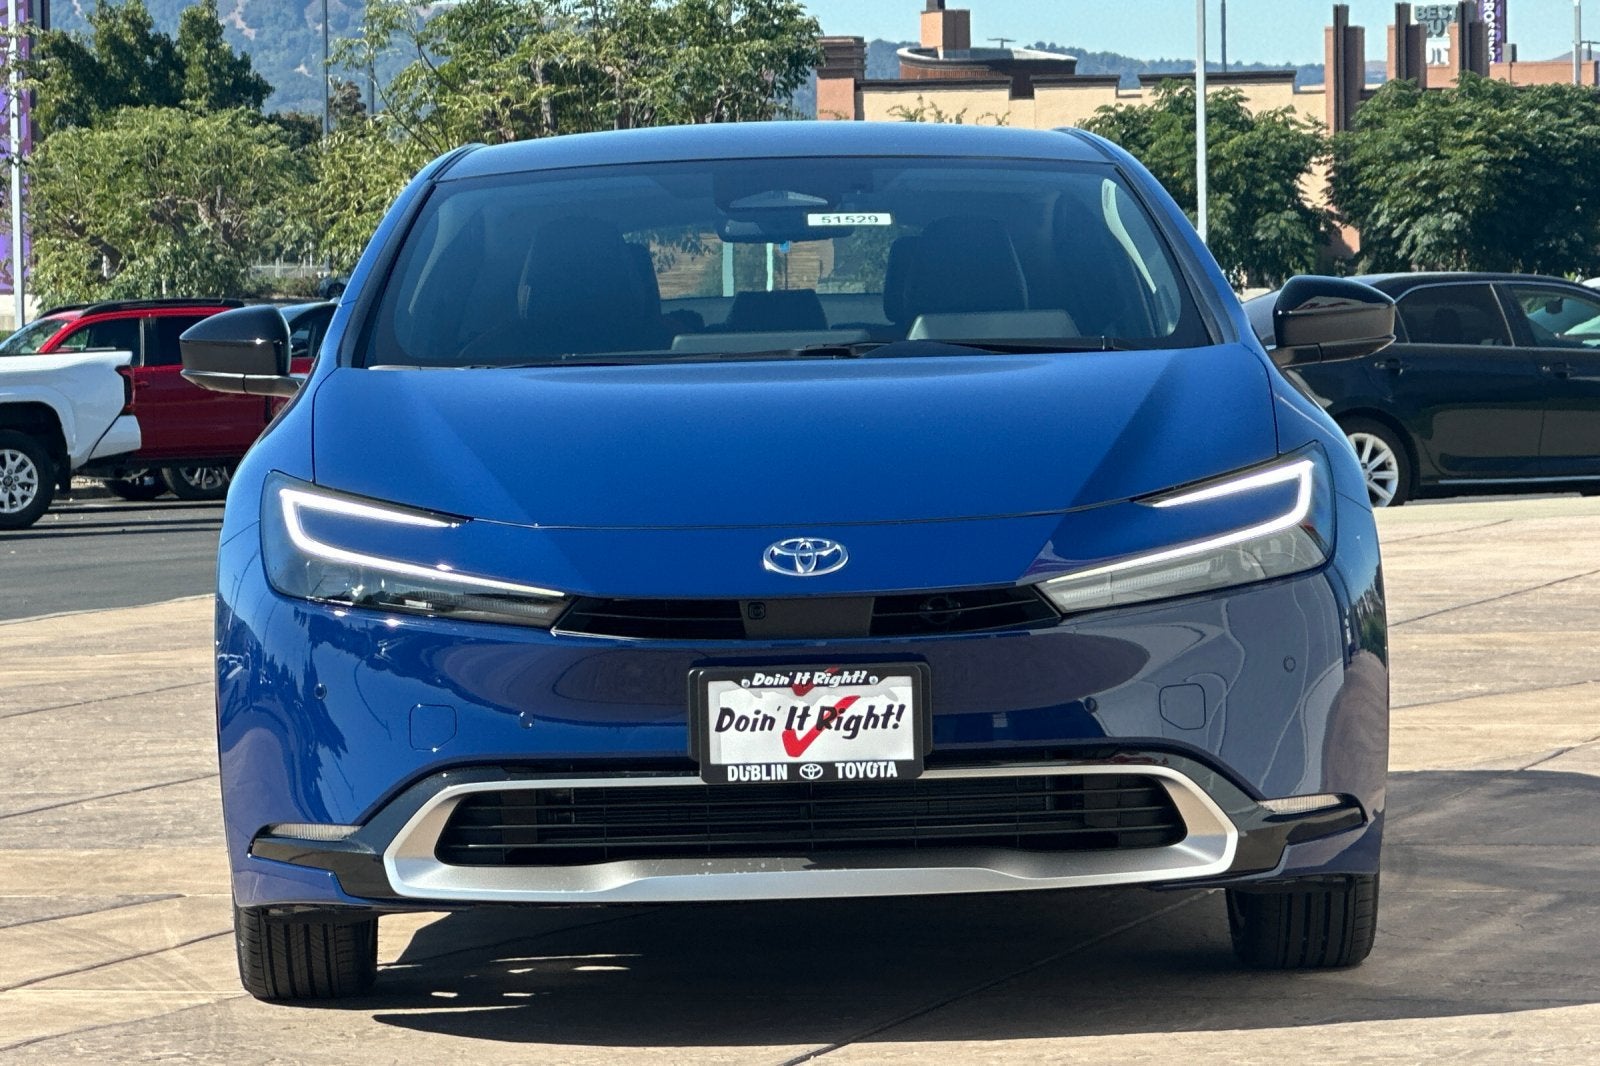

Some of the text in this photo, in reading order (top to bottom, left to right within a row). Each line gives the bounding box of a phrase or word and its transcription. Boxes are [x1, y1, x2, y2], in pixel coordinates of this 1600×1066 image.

[821, 215, 879, 224] 51529
[752, 670, 868, 687] Doin' It Right!
[714, 703, 906, 740] Doin' It Right!
[727, 761, 898, 782] DUBLIN TOYOTA
